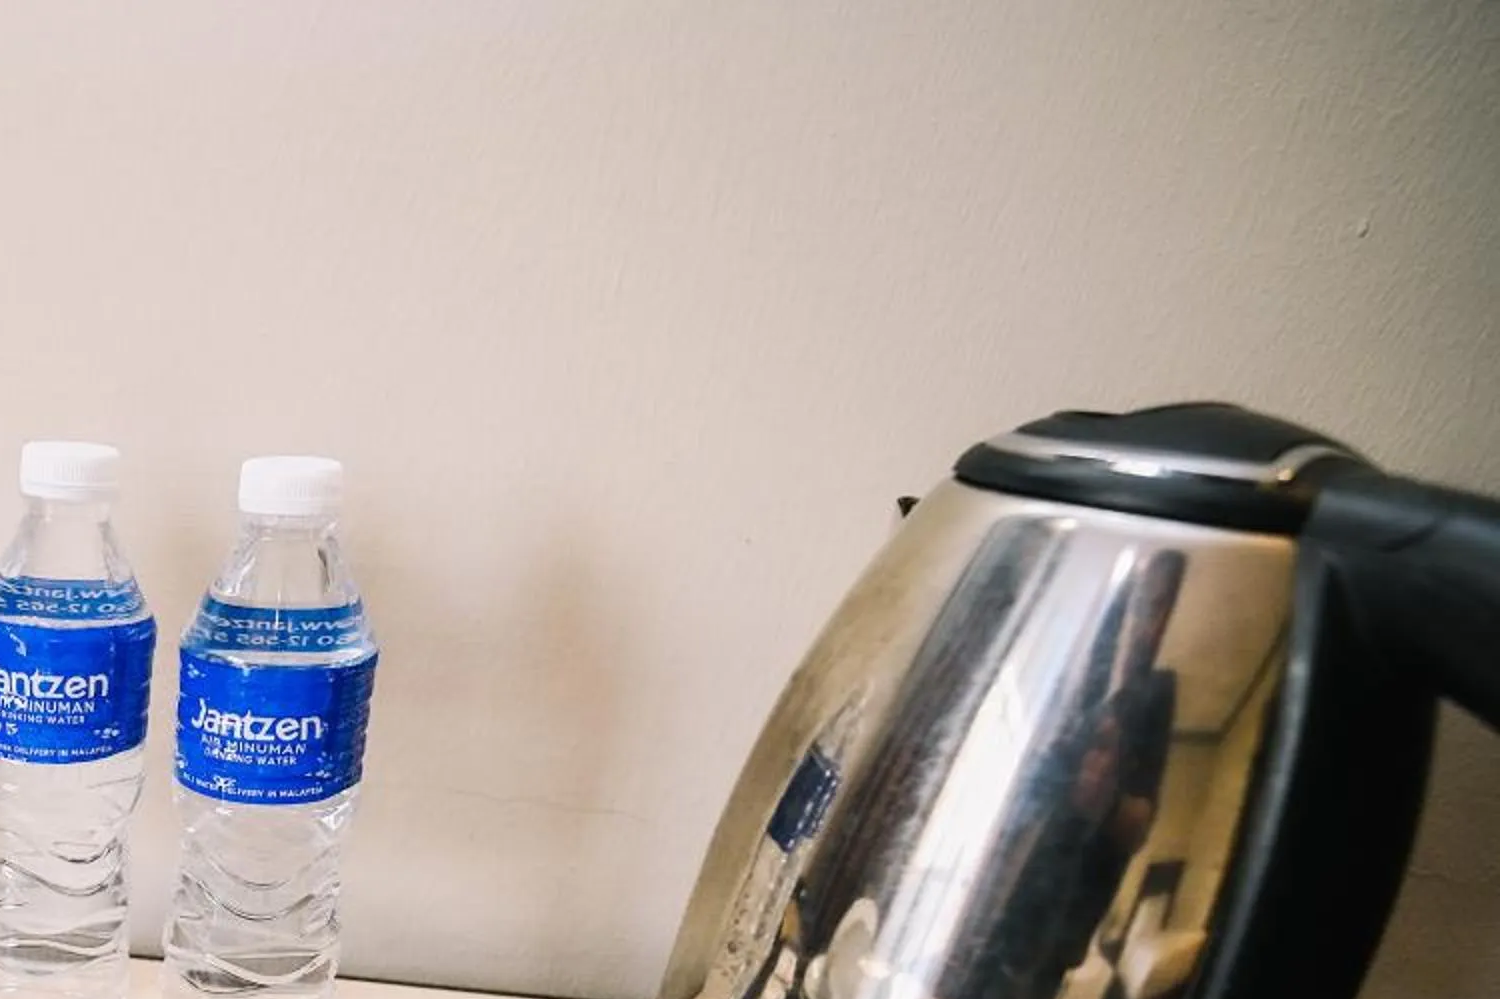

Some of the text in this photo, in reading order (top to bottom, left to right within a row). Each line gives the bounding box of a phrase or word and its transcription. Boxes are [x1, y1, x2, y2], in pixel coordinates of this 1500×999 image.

[46, 715, 84, 725] WATER
[191, 697, 321, 741] Jantzen
[226, 740, 306, 754] MINUMAN
[257, 755, 297, 766] WATER
